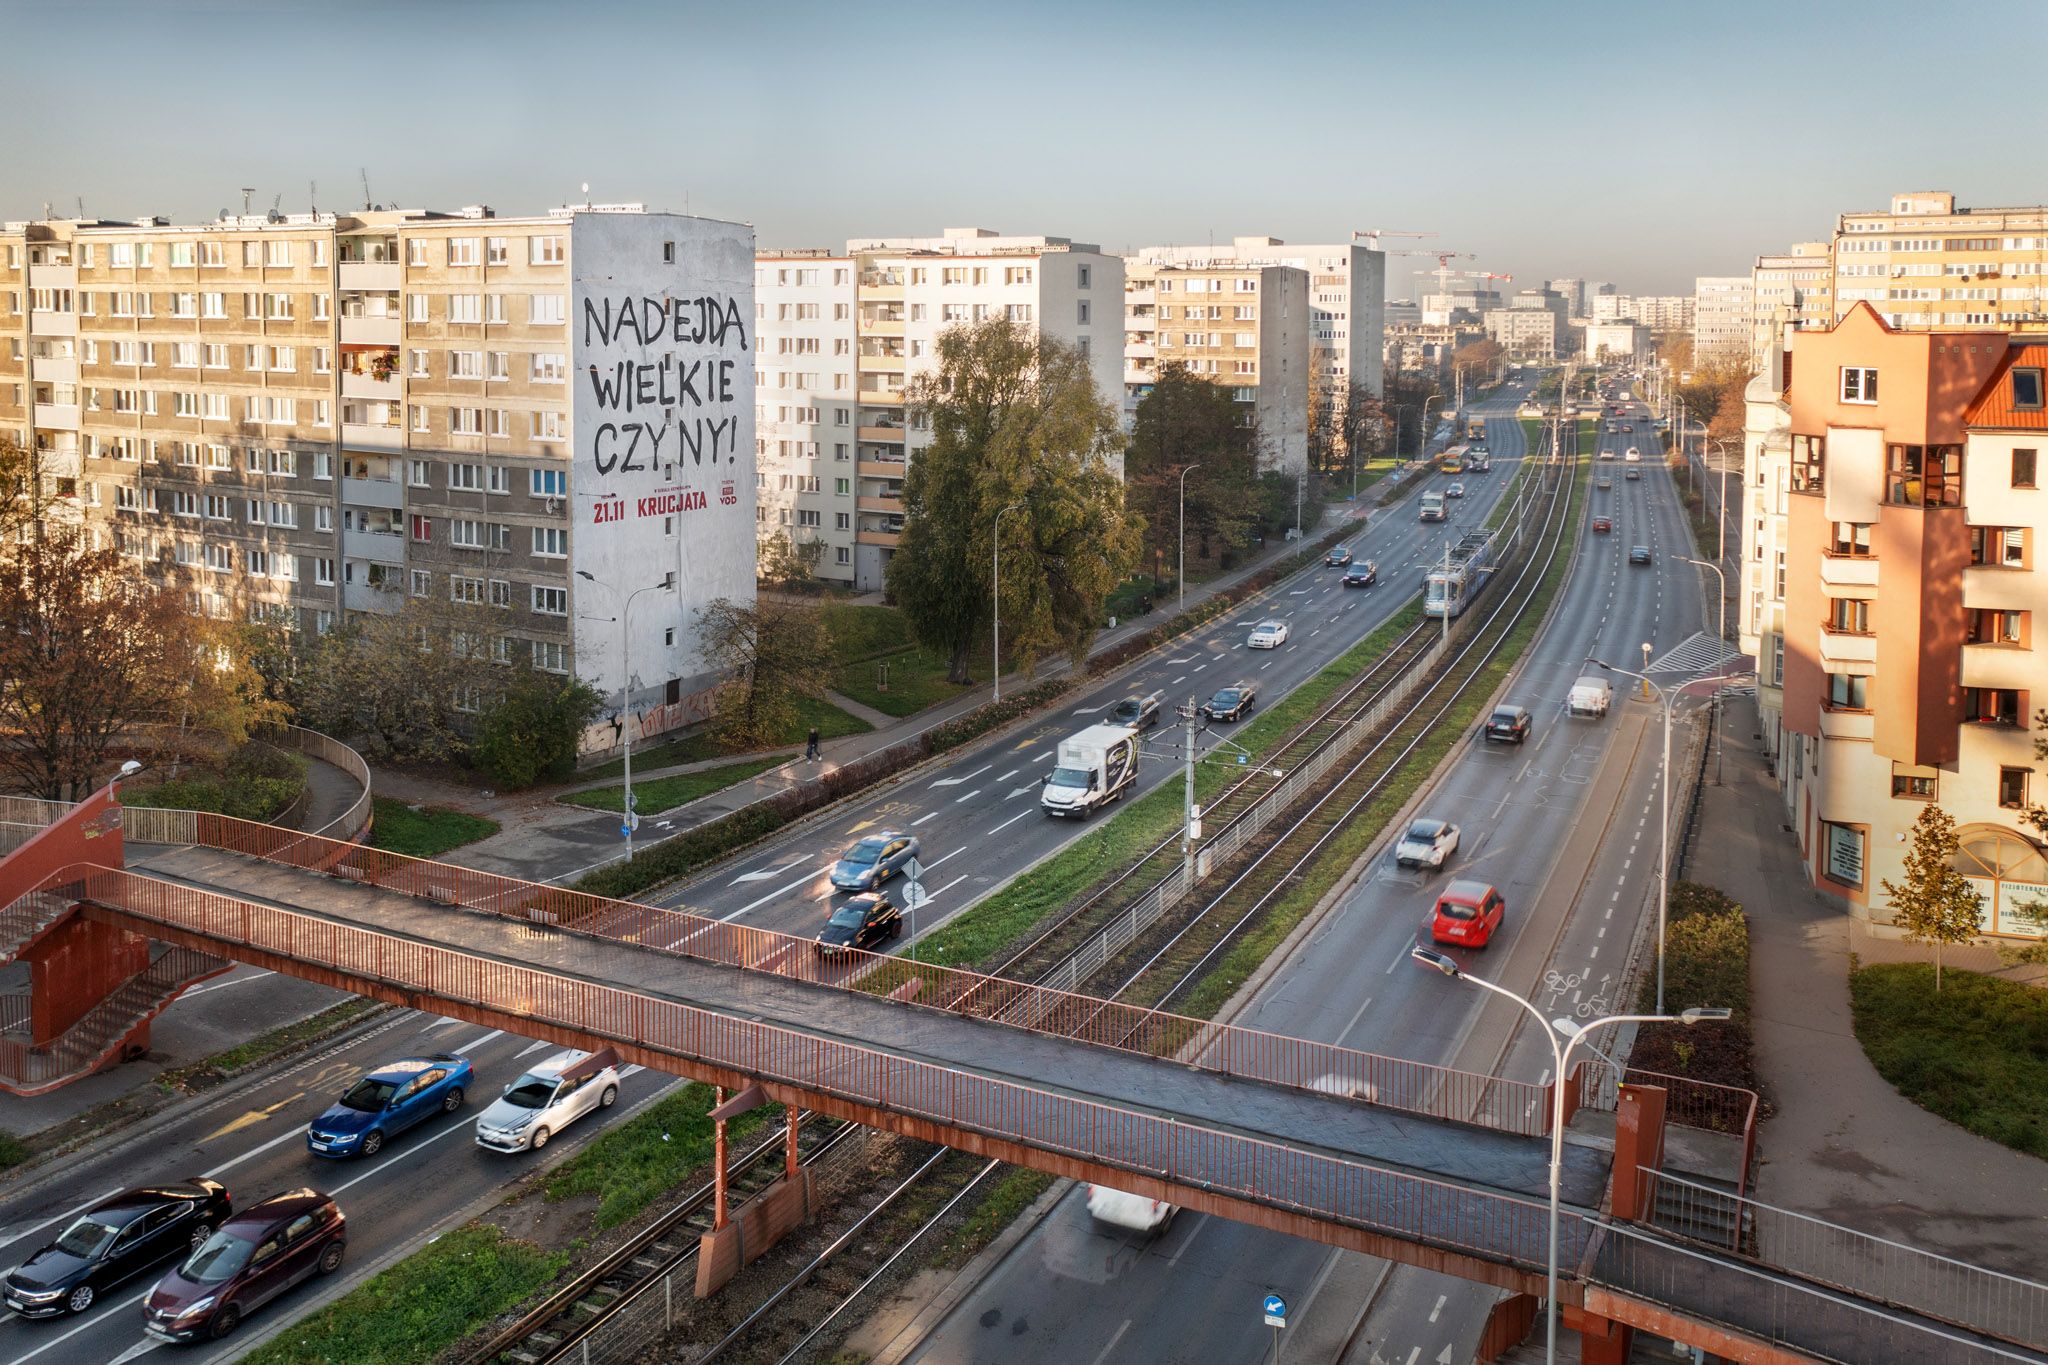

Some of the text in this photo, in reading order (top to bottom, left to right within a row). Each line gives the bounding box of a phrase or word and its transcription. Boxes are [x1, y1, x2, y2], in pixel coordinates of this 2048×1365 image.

[589, 360, 735, 413] WIELKIE
[593, 500, 625, 524] 21.11
[637, 490, 708, 518] KRUCJATA
[719, 495, 737, 506] VOD
